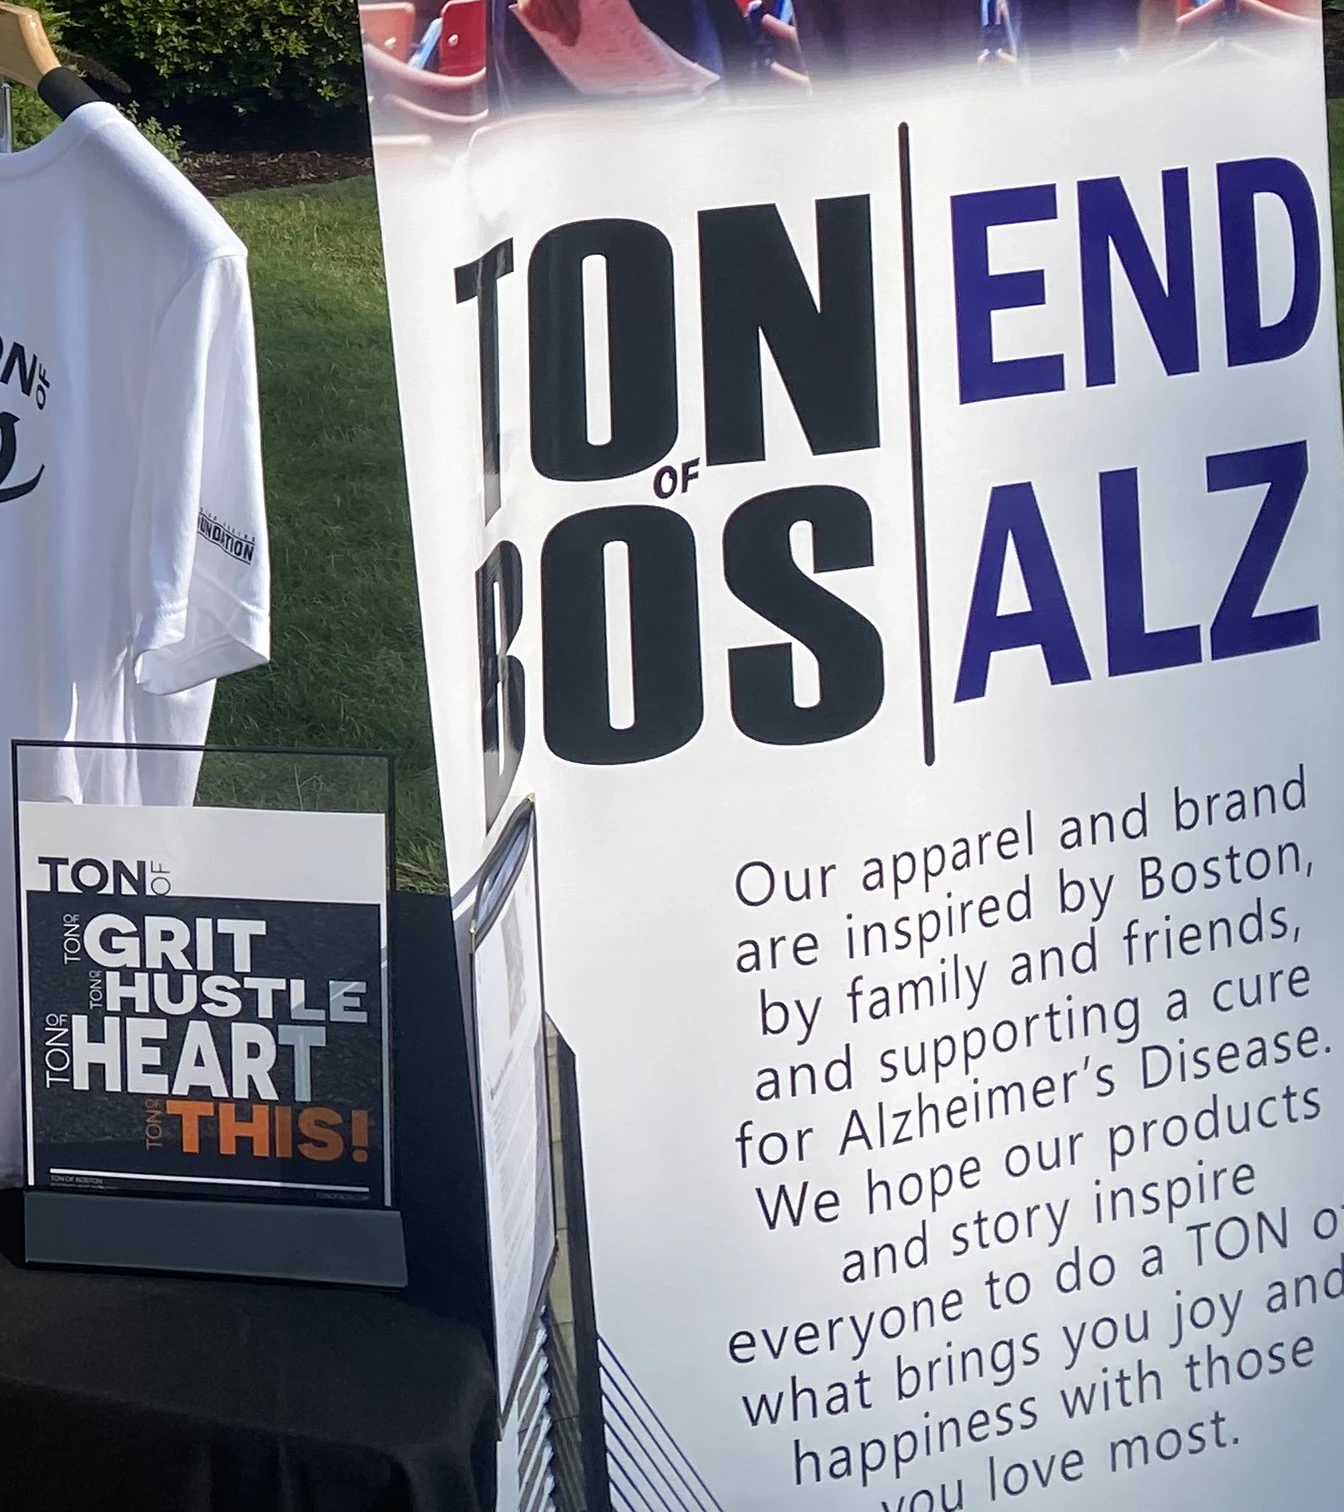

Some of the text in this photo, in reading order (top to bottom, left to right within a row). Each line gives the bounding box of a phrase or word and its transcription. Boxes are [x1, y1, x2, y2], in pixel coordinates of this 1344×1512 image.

[950, 156, 1322, 406] END
[34, 362, 50, 410] OF
[453, 194, 880, 529] TON
[653, 457, 701, 500] OF
[953, 439, 1320, 704] ALZ
[475, 484, 885, 836] BOS
[38, 856, 171, 896] TON OF
[734, 763, 1307, 907] Our apparel and brand
[63, 921, 81, 965] TON
[83, 913, 266, 972] GRIT
[735, 841, 1313, 973] are inspired by Boston,
[760, 897, 1301, 1046] by family and friends,
[45, 1013, 326, 1102] TON OF HEART
[89, 978, 104, 1010] TON
[105, 970, 368, 1023] HUSTLE
[755, 964, 1310, 1101] and supporting a cure
[146, 1109, 163, 1151] TON
[166, 1099, 370, 1163] THIS!
[734, 1024, 1332, 1169] for Alzheimer's Disease.
[756, 1084, 1321, 1230] We hope our products
[728, 1202, 1344, 1363] everyone to do a TON o
[842, 1159, 1256, 1283] and story inspire
[742, 1252, 1344, 1427] what brings you joy and
[793, 1336, 1315, 1487] happiness with those
[988, 1448, 1084, 1503] love
[1109, 1410, 1241, 1473] most.
